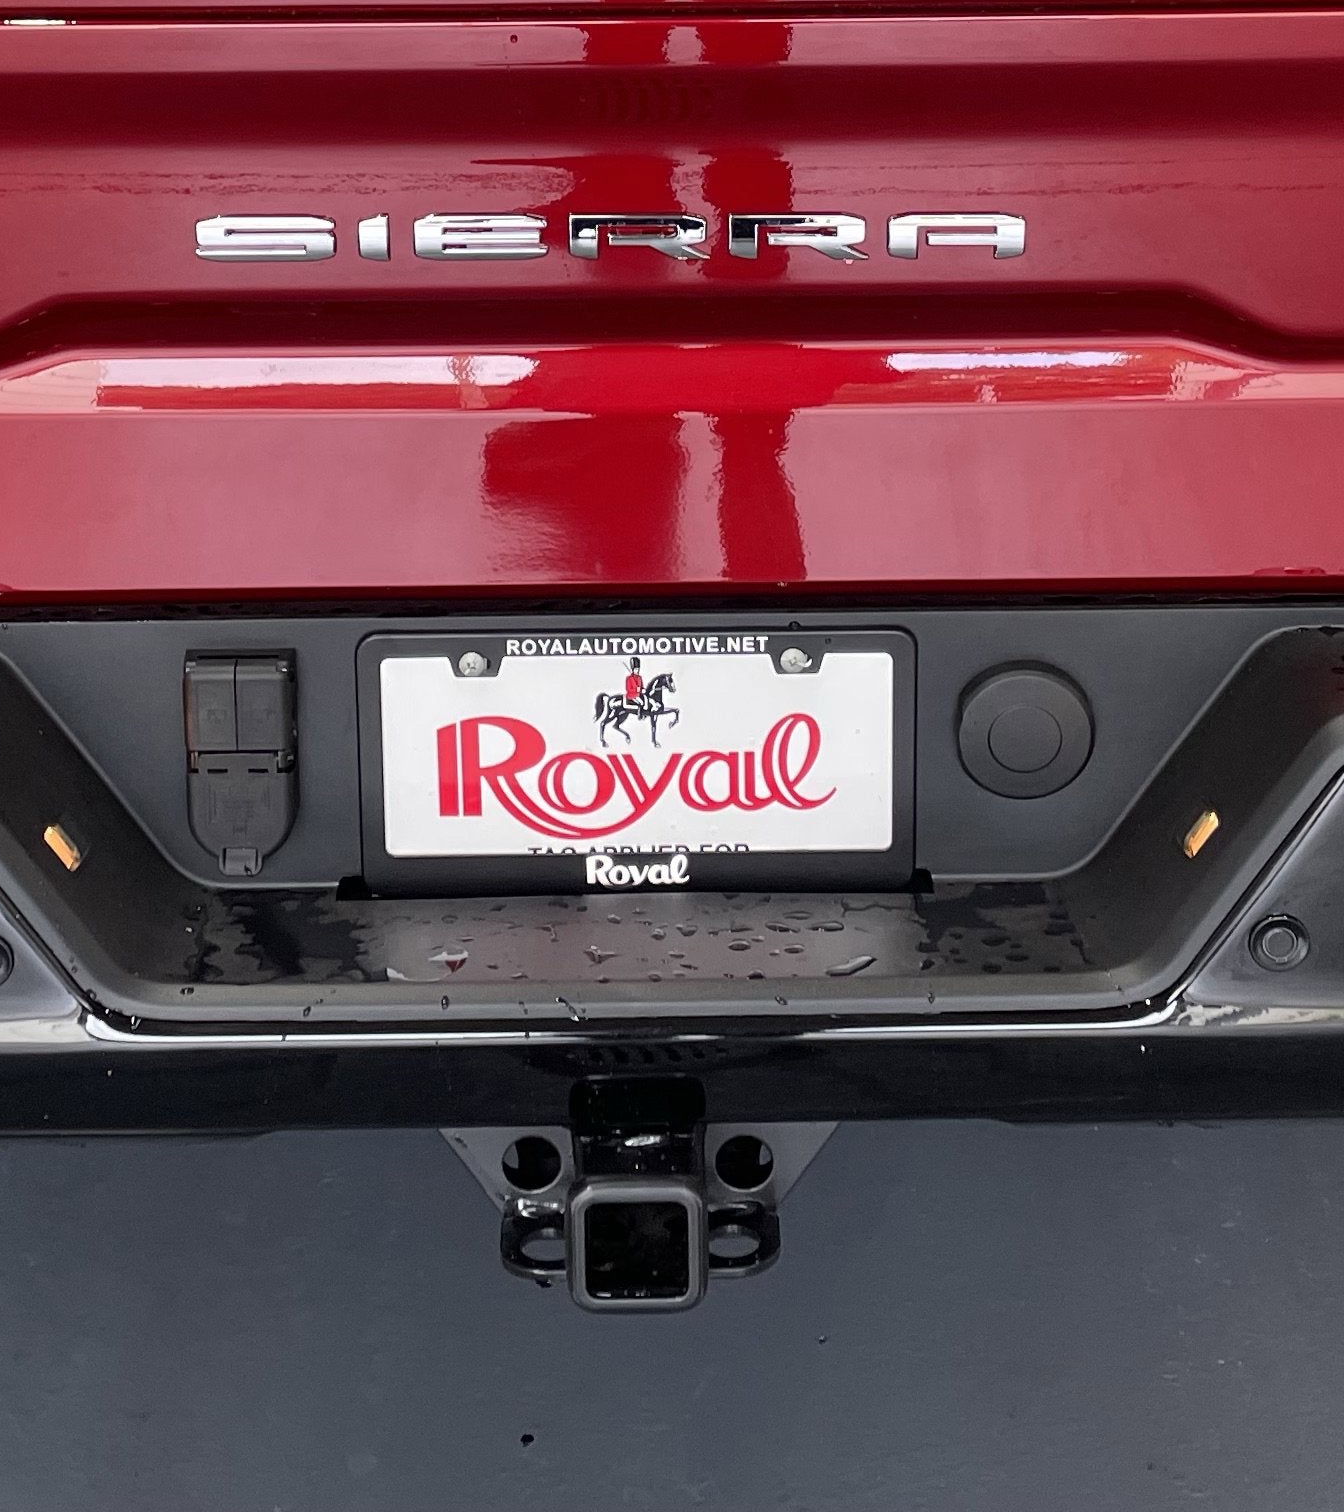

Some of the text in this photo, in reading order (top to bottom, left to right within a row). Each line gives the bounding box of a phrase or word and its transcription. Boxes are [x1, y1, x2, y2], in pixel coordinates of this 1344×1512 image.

[194, 213, 1027, 263] SIERRA
[506, 636, 769, 656] ROYALAUTOMOTIVE.NET
[436, 712, 837, 840] Royal
[585, 853, 690, 887] Royal
